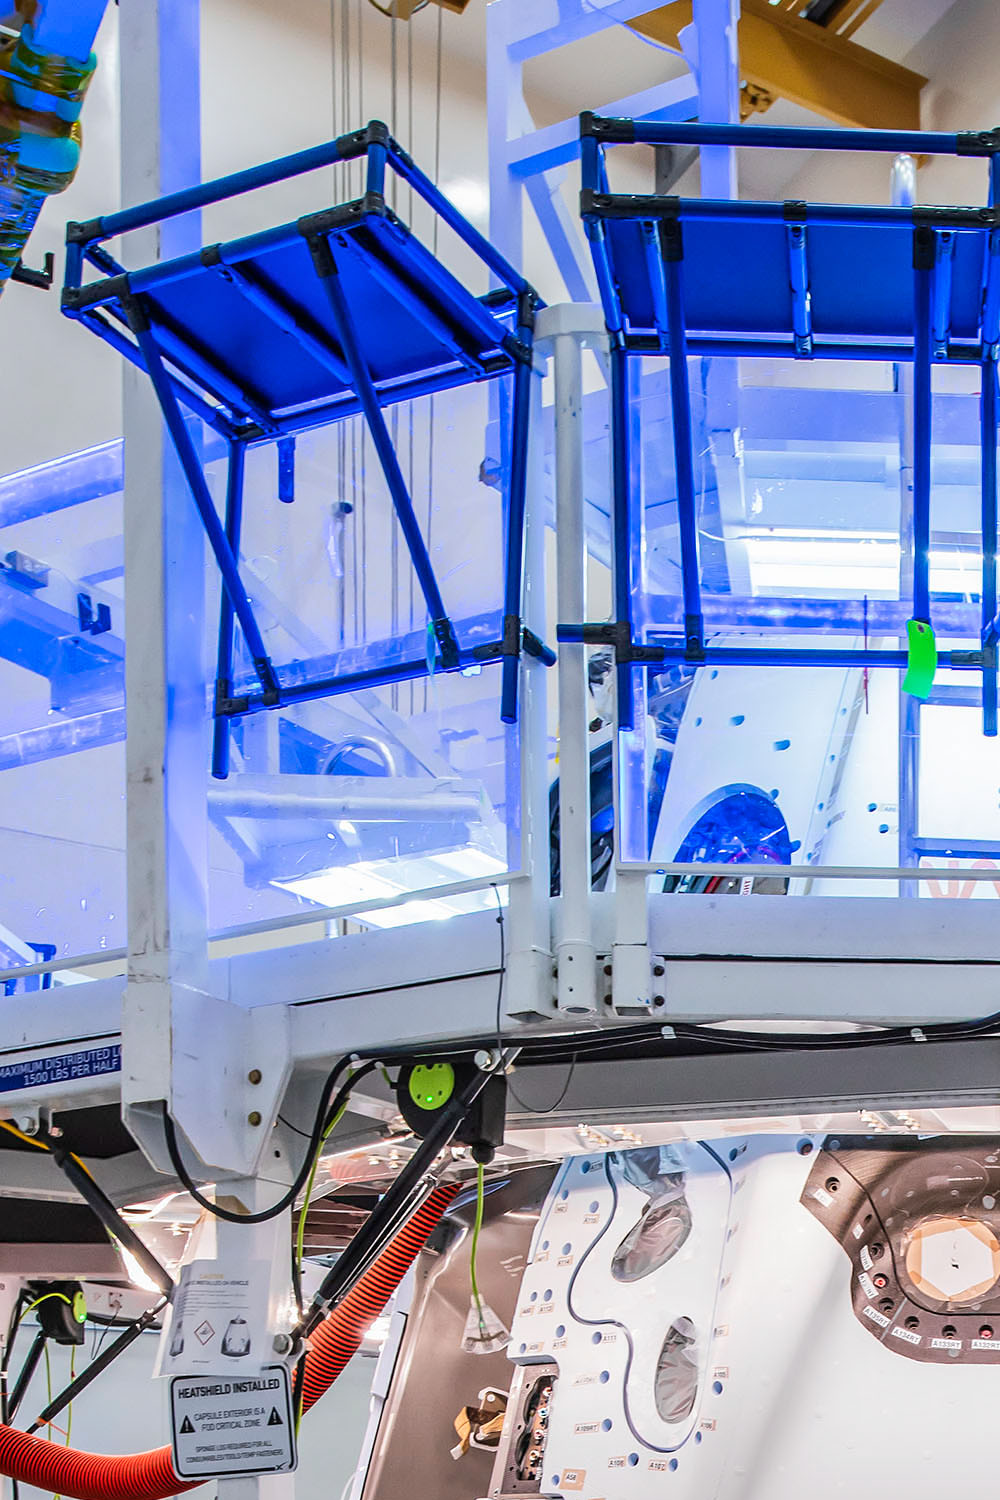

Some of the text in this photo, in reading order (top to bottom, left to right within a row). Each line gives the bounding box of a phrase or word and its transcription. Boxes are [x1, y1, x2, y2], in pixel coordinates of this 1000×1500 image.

[45, 1048, 110, 1070] DISTRIBUTED
[23, 1058, 118, 1086] 1500 LBS PER HALF
[178, 1379, 280, 1399] HEATSHIELD INSTALLED
[193, 1410, 223, 1421] CAPSULE
[223, 1407, 253, 1419] EXTERIOR
[254, 1407, 261, 1416] IS
[216, 1420, 244, 1430] CRITICAL
[244, 1418, 261, 1428] ZONE
